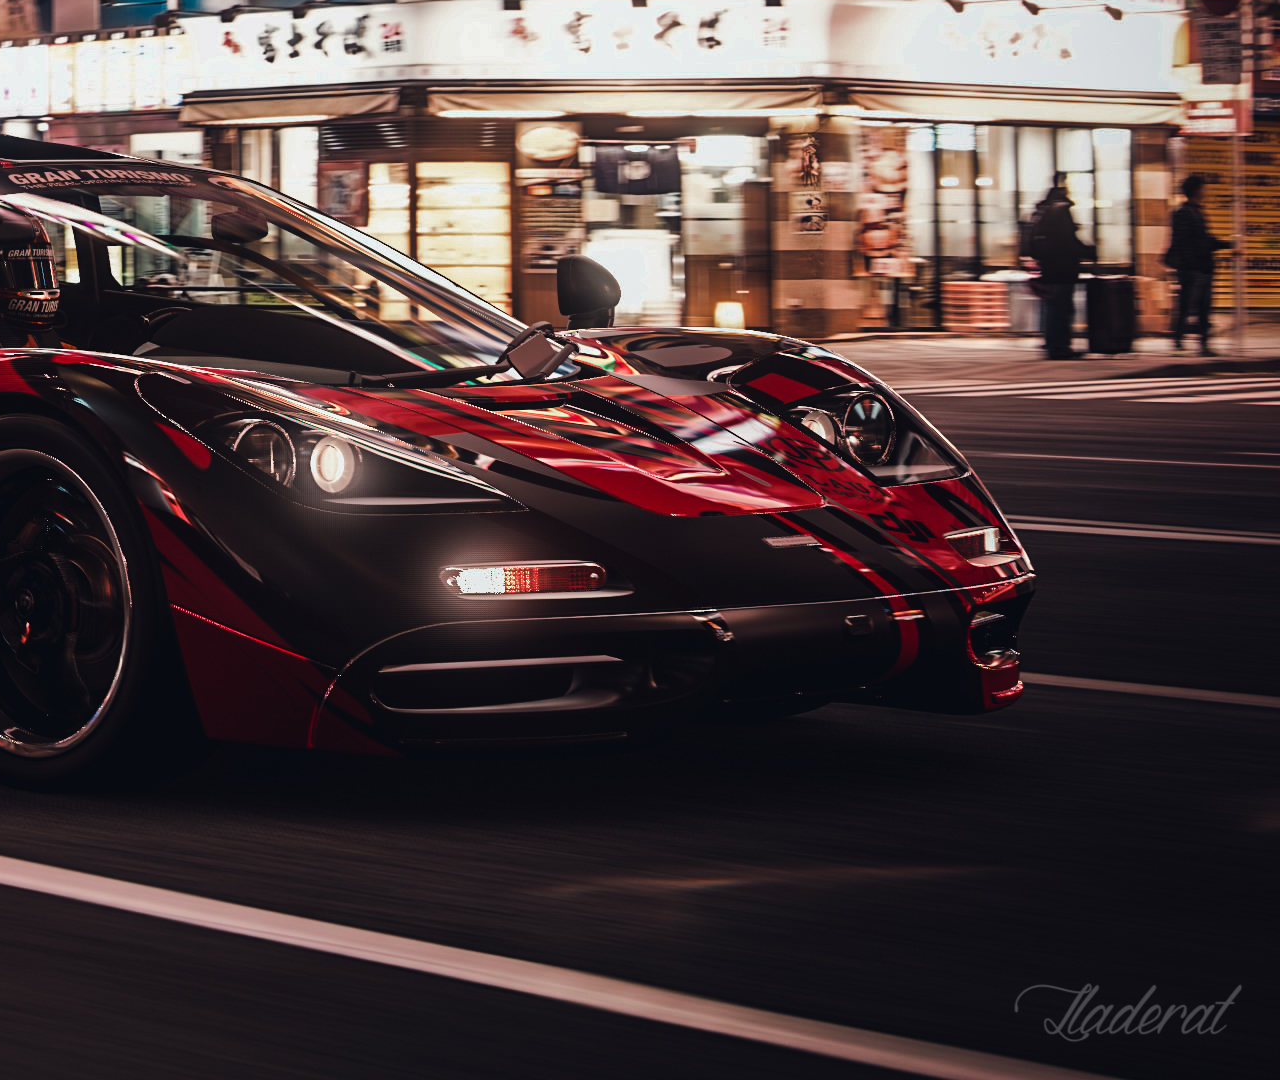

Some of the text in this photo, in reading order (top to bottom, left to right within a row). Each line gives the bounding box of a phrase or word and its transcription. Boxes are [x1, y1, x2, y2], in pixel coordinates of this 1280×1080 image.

[8, 169, 191, 185] GRAN TURISMO
[8, 249, 30, 257] GRAN
[8, 299, 40, 312] GRAN
